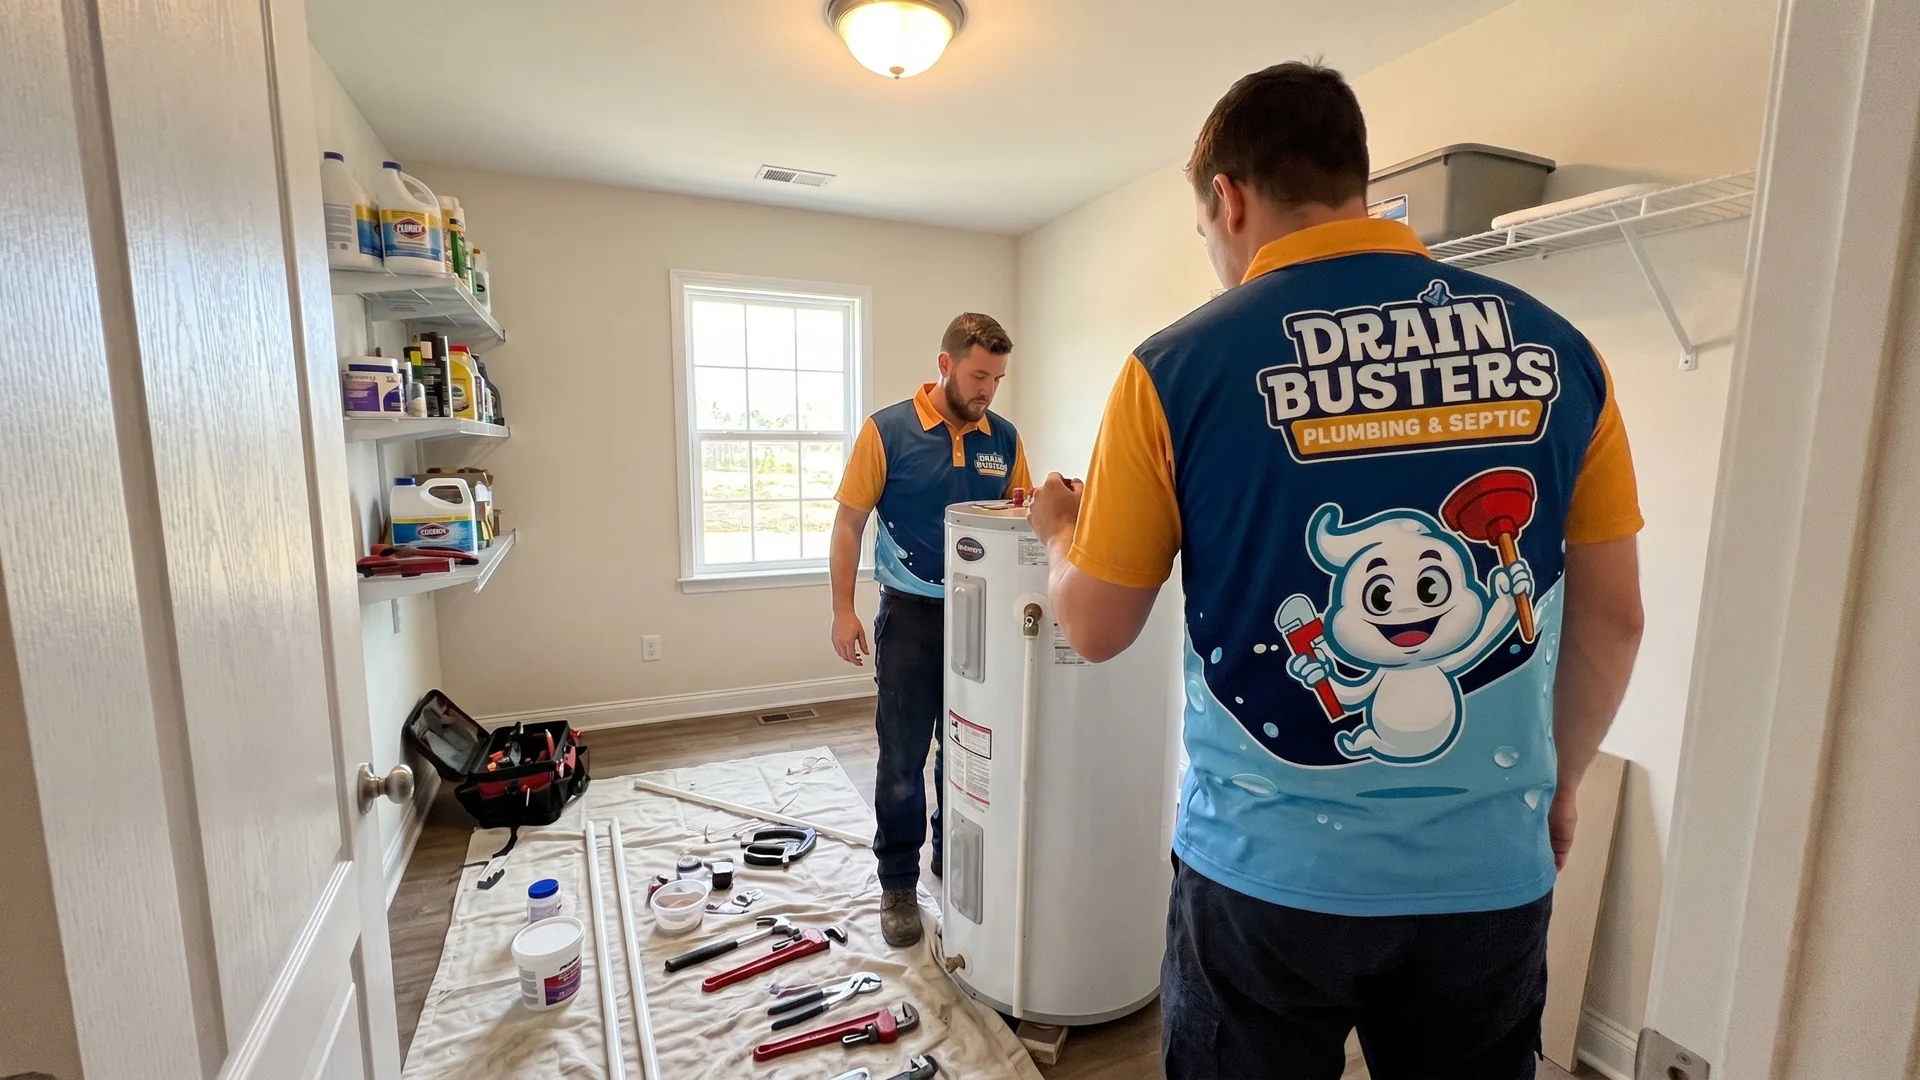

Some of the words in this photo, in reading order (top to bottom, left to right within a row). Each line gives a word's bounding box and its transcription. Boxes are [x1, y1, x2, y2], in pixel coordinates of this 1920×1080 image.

[1294, 302, 1506, 366] DRAIN
[1267, 352, 1554, 421] BUSTERS
[1304, 419, 1421, 446] PLUMBING
[1429, 417, 1443, 434] &
[1449, 409, 1531, 433] SEPTIC
